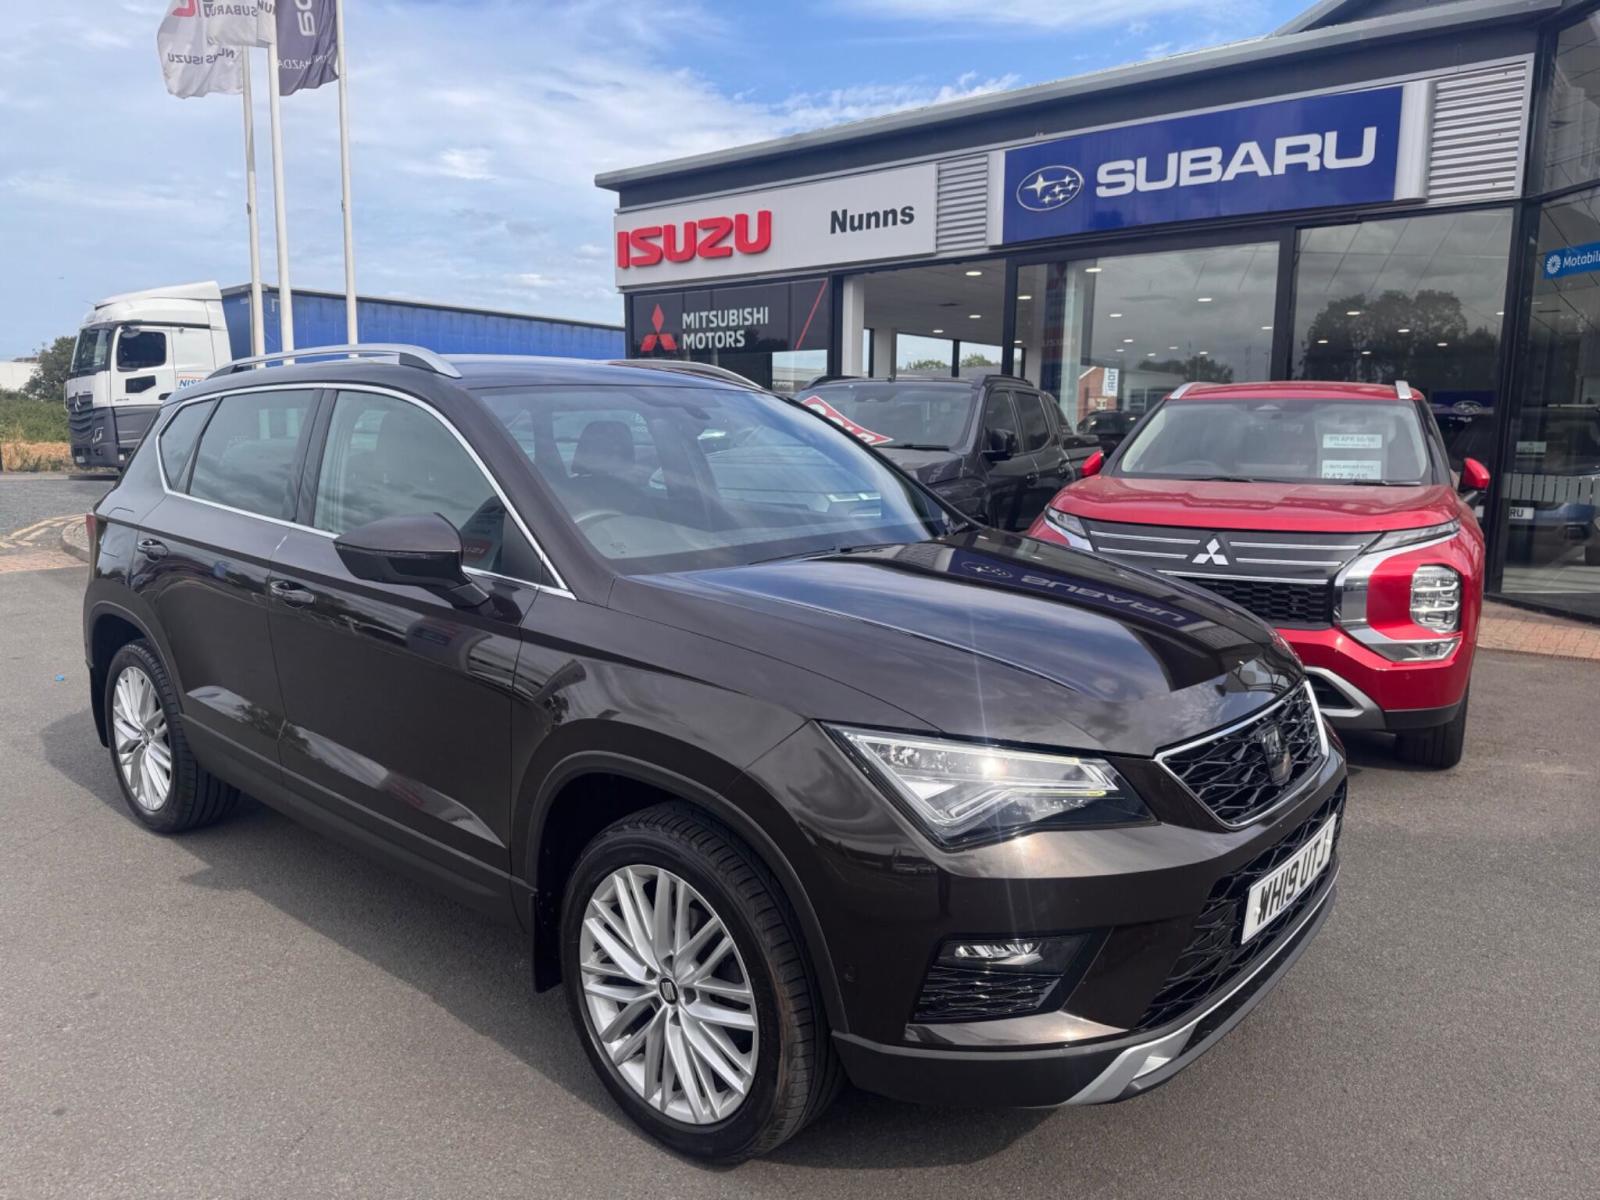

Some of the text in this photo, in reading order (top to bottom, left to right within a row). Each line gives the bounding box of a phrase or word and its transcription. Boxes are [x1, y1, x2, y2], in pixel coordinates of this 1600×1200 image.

[1096, 126, 1377, 198] SUBARU
[830, 205, 914, 234] Nunns
[617, 210, 772, 269] ISUZU
[682, 306, 769, 329] MITSUBISHI
[682, 330, 745, 350] MOTORS
